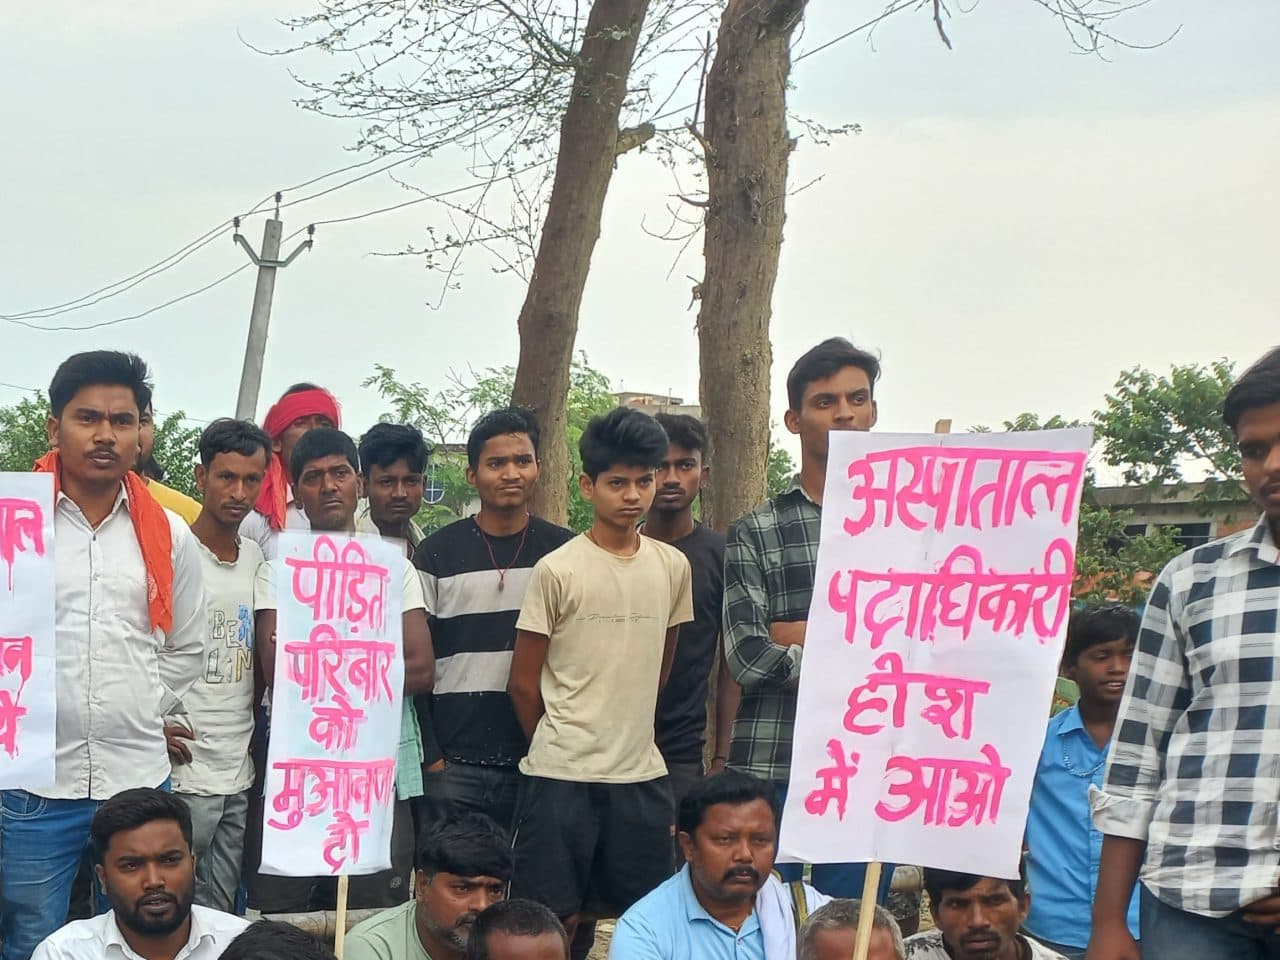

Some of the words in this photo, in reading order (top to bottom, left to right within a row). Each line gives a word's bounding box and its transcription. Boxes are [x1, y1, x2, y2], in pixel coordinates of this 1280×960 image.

[843, 652, 991, 740] होश
[804, 739, 860, 821] में
[875, 743, 1012, 827] आओ
